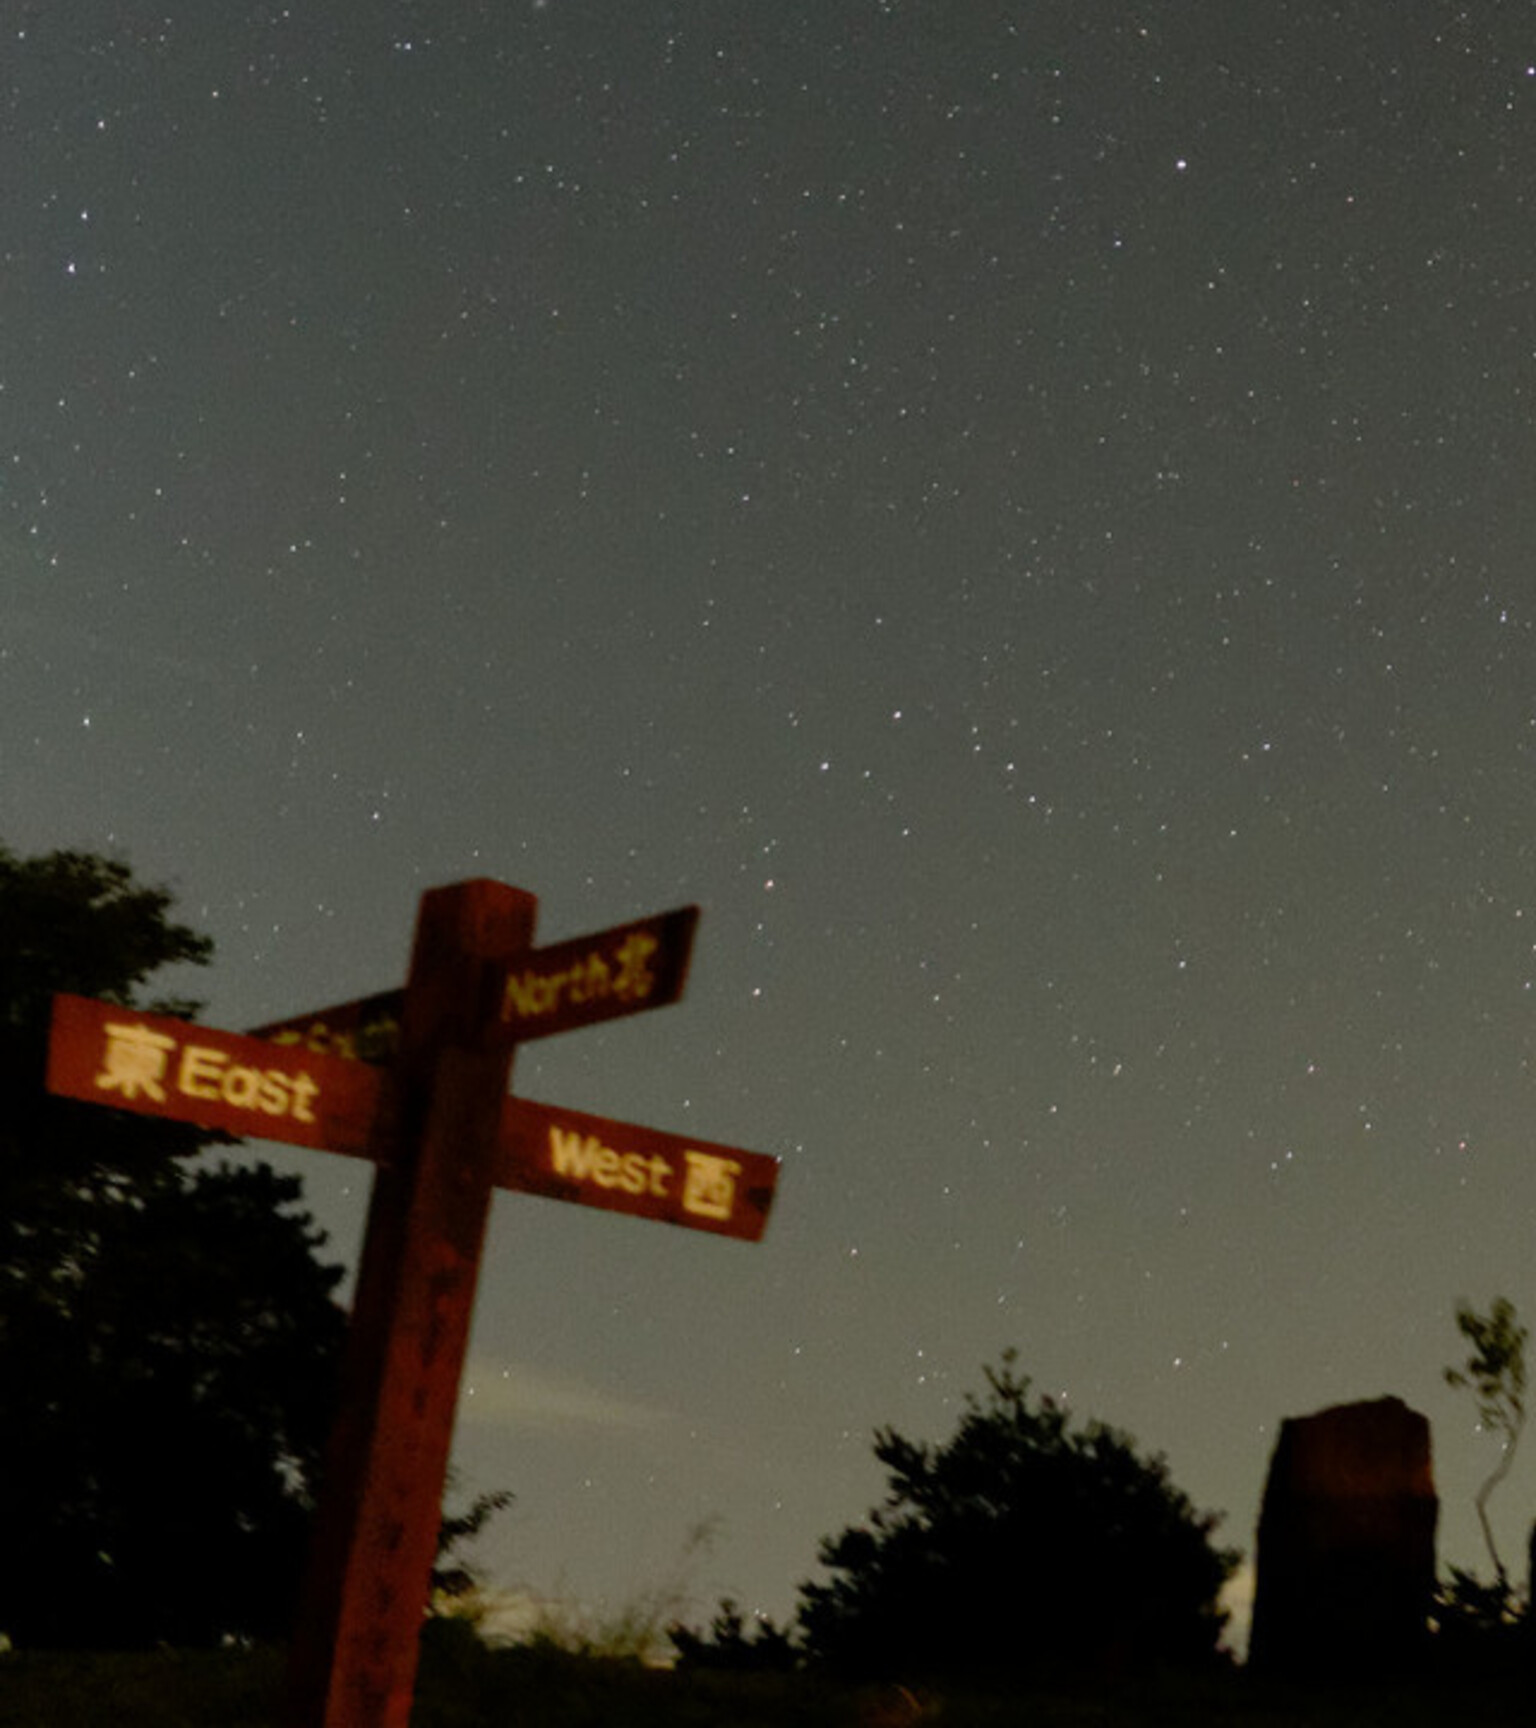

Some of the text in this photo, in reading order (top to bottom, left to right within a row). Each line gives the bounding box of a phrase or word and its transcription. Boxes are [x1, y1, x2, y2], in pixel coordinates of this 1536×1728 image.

[502, 952, 609, 1022] North
[96, 1021, 177, 1103] 東
[178, 1044, 321, 1124] East
[550, 1125, 742, 1221] West 西
